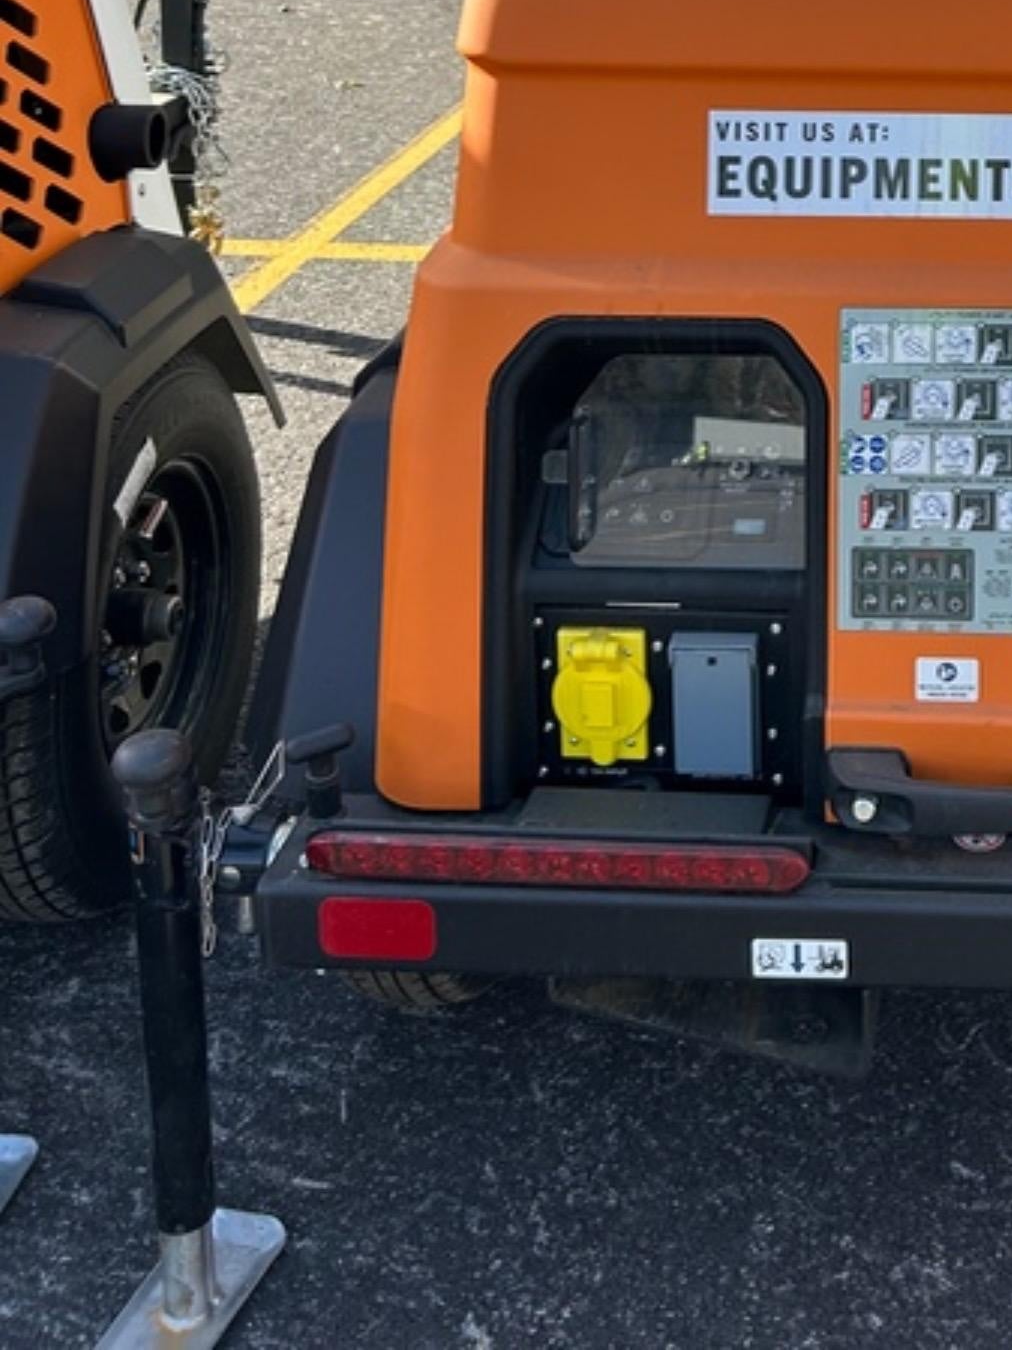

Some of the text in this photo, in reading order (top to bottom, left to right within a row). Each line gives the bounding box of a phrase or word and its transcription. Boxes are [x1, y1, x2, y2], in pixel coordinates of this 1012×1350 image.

[716, 121, 889, 143] VISIT US AT:
